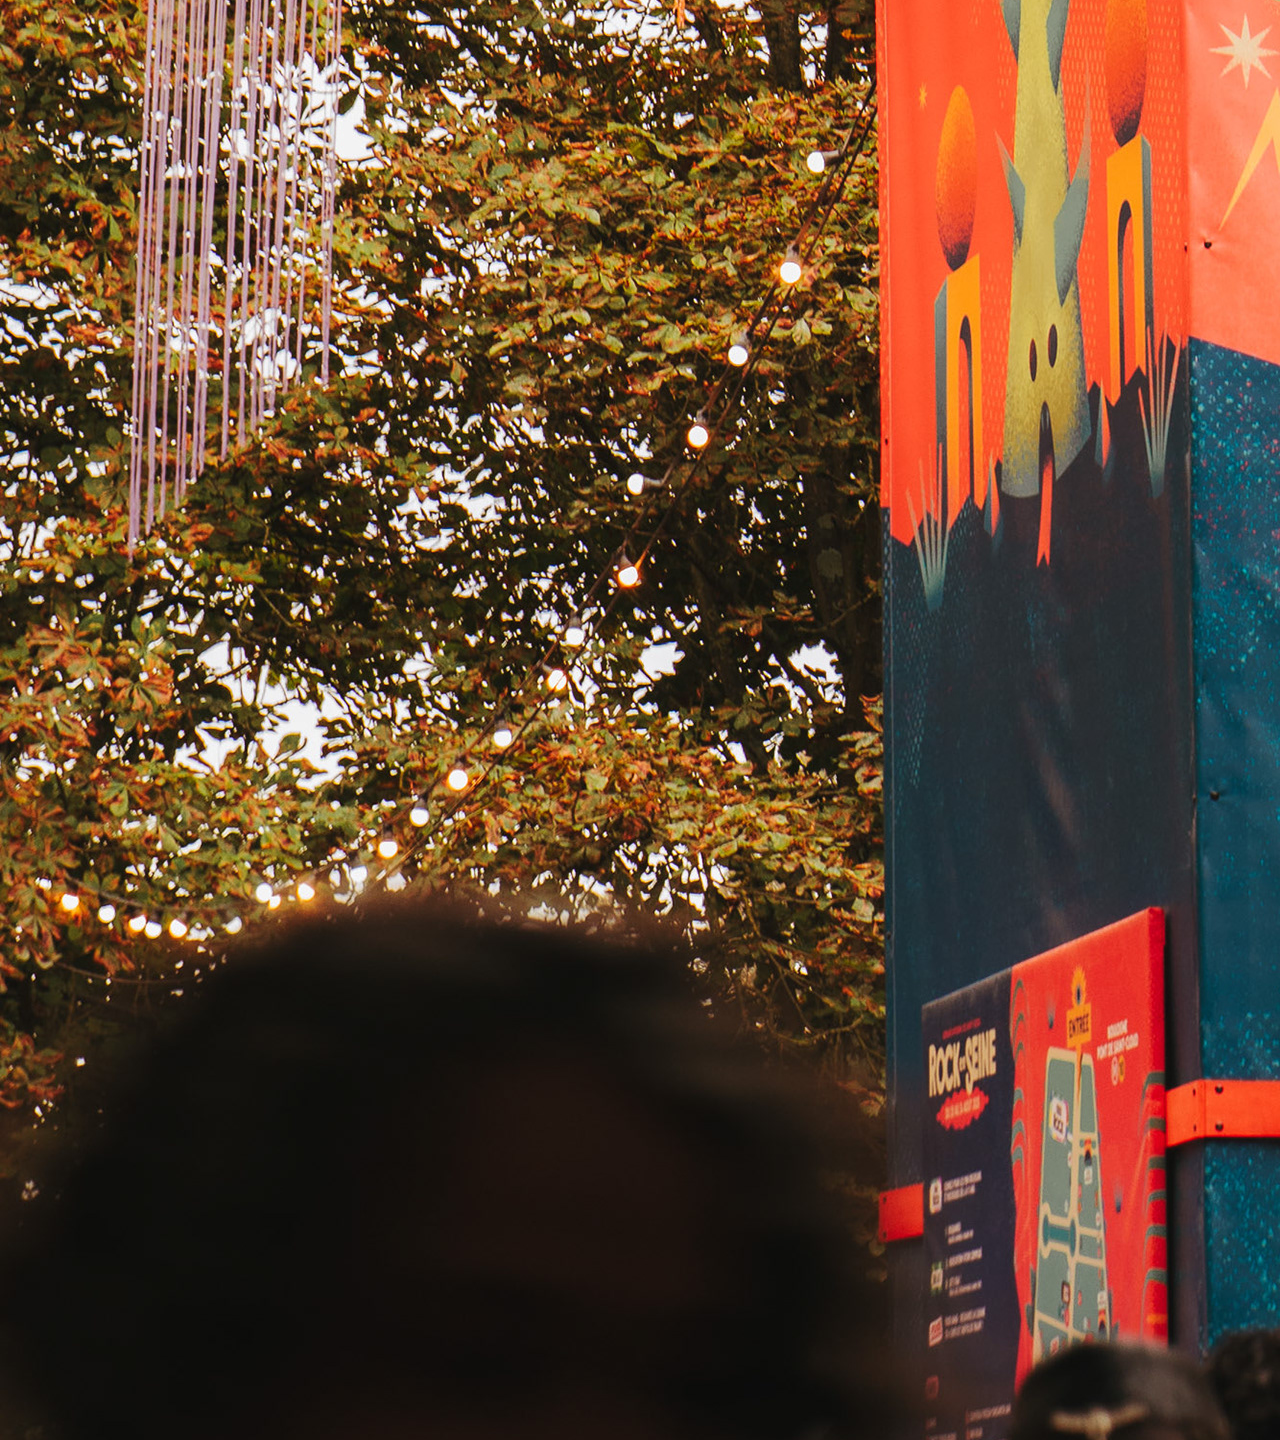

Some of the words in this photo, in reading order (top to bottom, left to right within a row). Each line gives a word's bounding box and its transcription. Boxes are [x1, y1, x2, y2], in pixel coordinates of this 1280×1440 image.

[1067, 1012, 1089, 1039] ENTRÉE
[929, 1041, 961, 1098] ROCK
[965, 1027, 997, 1097] SEINE
